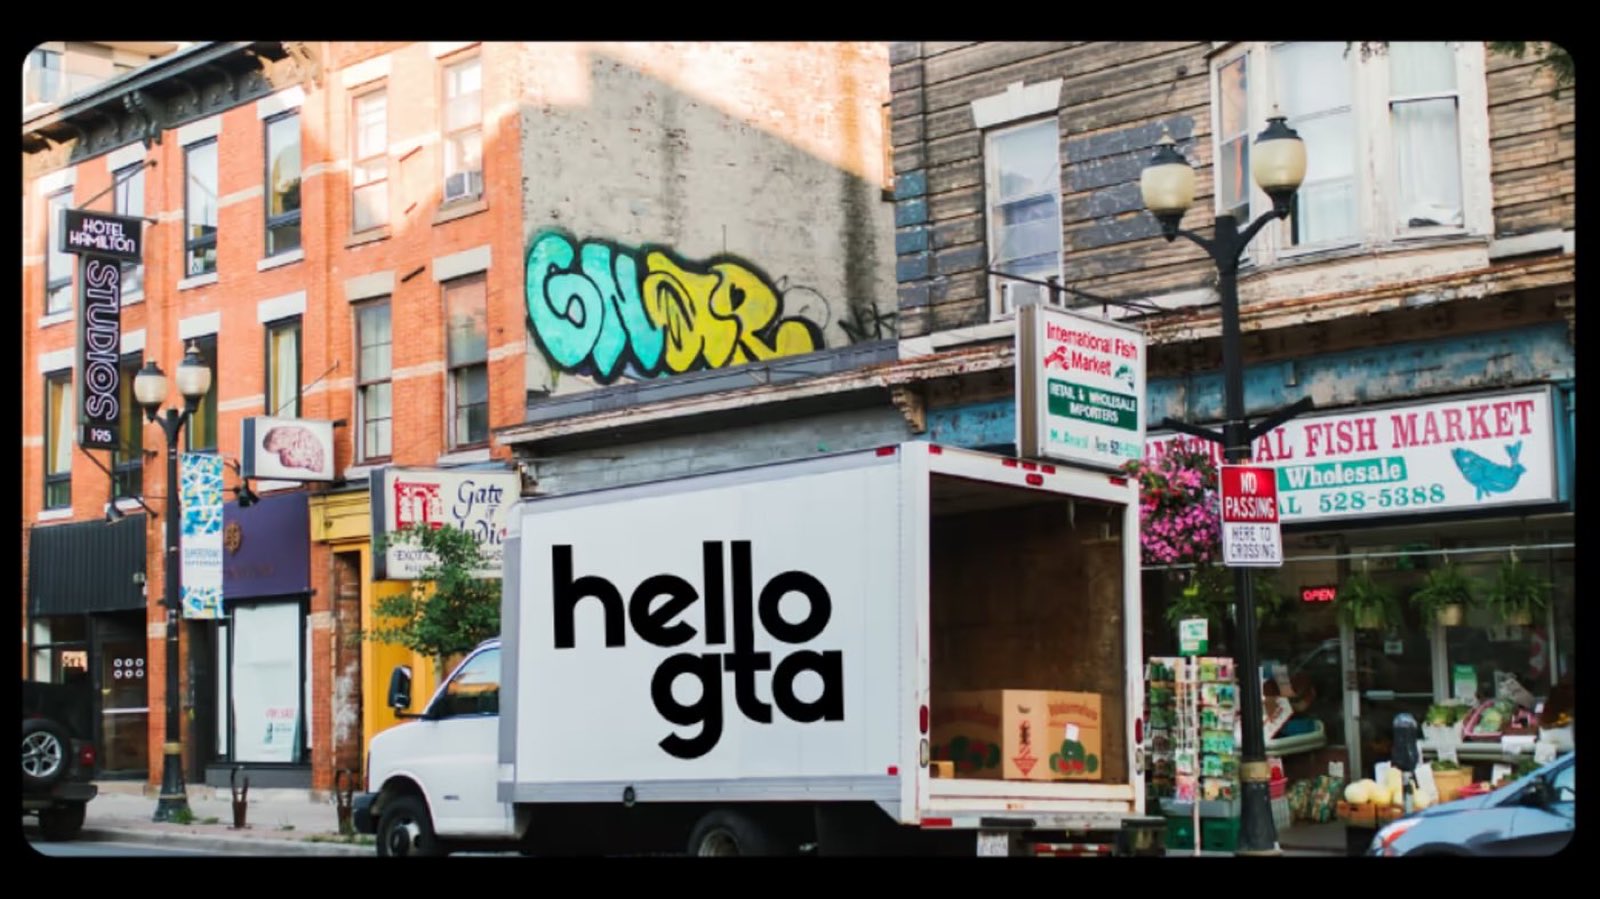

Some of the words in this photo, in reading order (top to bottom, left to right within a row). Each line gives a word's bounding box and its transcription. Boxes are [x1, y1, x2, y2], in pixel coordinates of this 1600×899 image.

[83, 218, 126, 237] HOTEL
[86, 260, 119, 420] STUDIOS
[1046, 320, 1113, 355] International
[1115, 337, 1138, 360] Fish
[1071, 350, 1112, 377] Market
[1049, 382, 1076, 400] RETAIL
[1088, 392, 1137, 412] WHOLESALE
[1069, 402, 1120, 423] IMPORTERS
[90, 428, 112, 442] 195
[1304, 417, 1378, 458] FISH
[1390, 400, 1536, 450] MARKET
[1240, 471, 1258, 495] NO
[1285, 458, 1402, 490] Wholesale
[452, 480, 503, 520] Gate
[1225, 496, 1275, 519] PASSING
[1318, 484, 1446, 513] 528-5388
[1232, 526, 1256, 541] HERE
[1259, 526, 1271, 541] TO
[1231, 543, 1275, 559] CROSSING
[552, 540, 832, 649] hello
[1303, 588, 1335, 601] OPEN
[650, 650, 845, 760] gta
